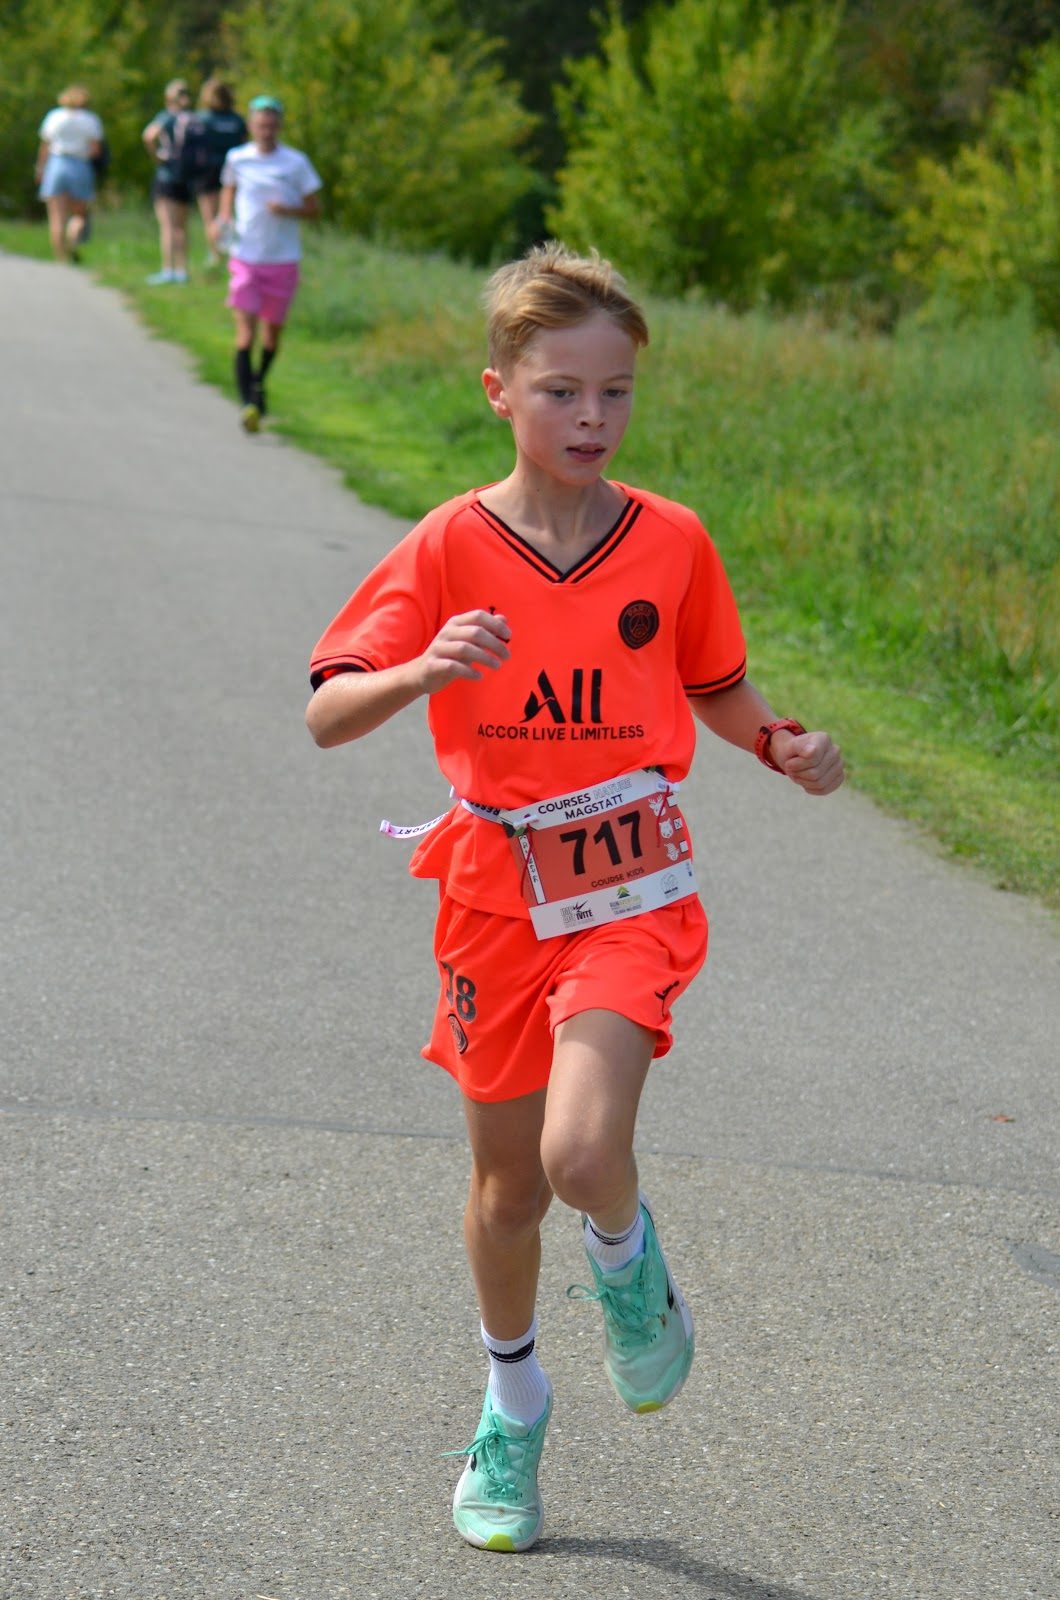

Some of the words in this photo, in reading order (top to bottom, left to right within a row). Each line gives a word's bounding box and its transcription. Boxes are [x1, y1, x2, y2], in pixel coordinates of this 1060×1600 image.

[477, 723, 529, 740] ACCOR
[532, 727, 566, 741] LIVE
[571, 724, 645, 741] LIMITLESS
[537, 792, 591, 815] COURSES
[564, 793, 624, 820] MAGSTATT
[559, 810, 643, 876] 717
[591, 873, 625, 889] COURSE
[626, 866, 645, 880] KIDS
